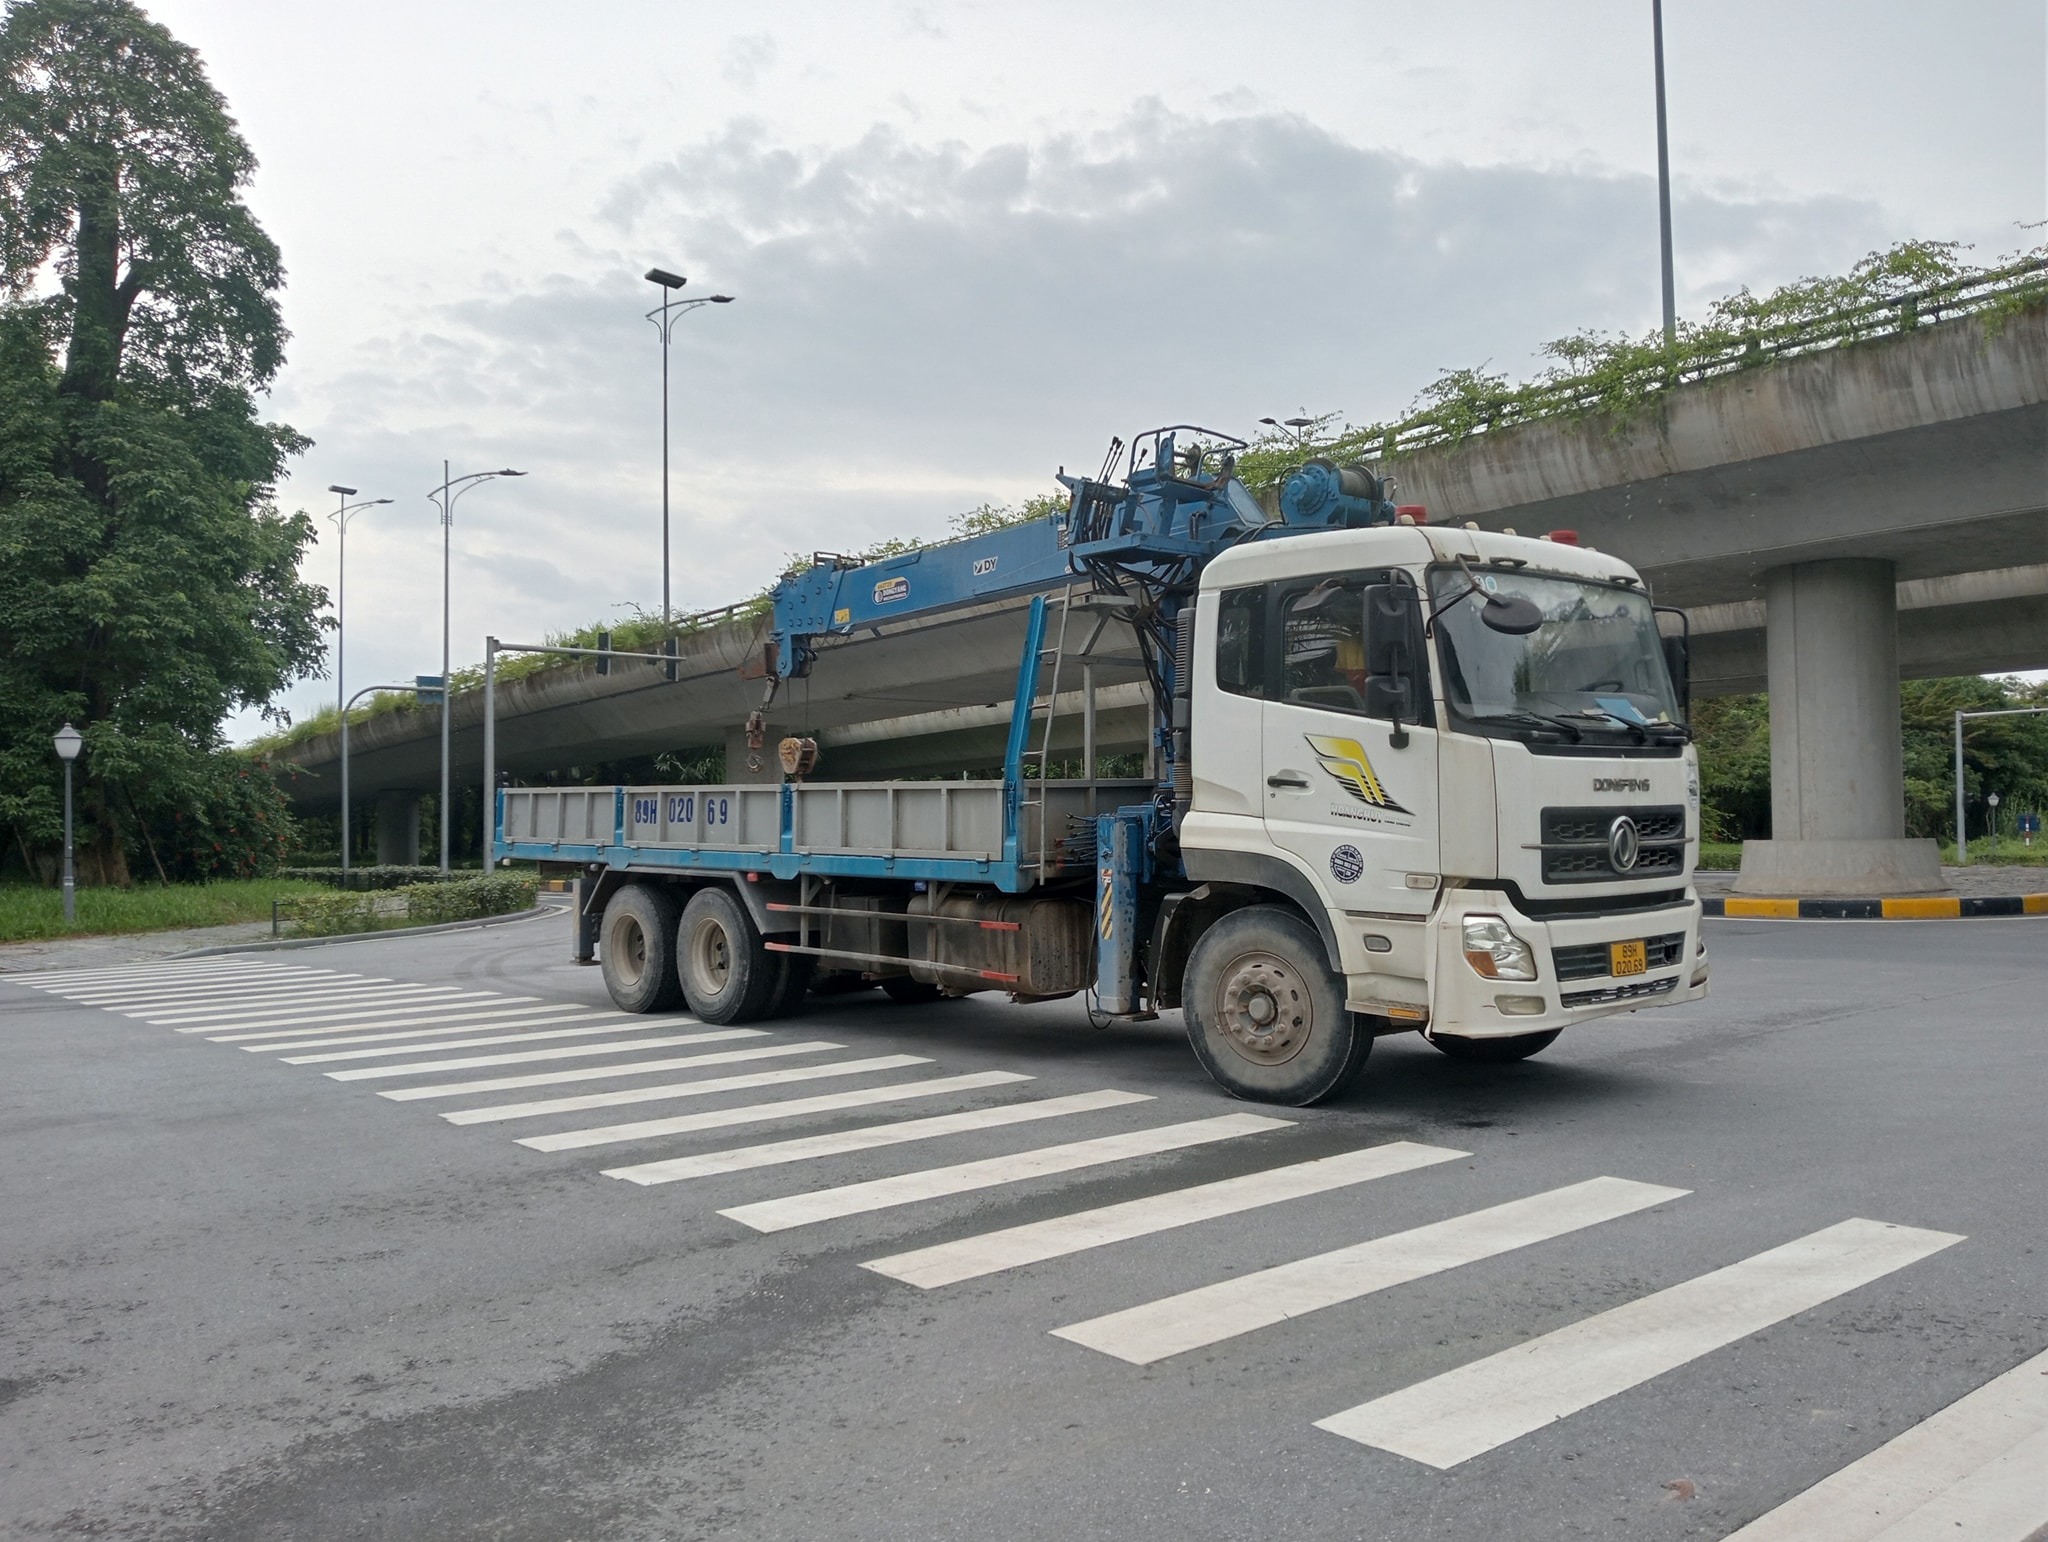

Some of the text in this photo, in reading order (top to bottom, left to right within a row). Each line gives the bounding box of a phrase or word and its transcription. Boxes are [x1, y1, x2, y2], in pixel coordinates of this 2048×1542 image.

[983, 558, 997, 571] DY
[635, 799, 657, 824] 89H
[668, 797, 694, 823] 020
[1622, 943, 1638, 958] 89H
[1616, 958, 1643, 975] 020.69
